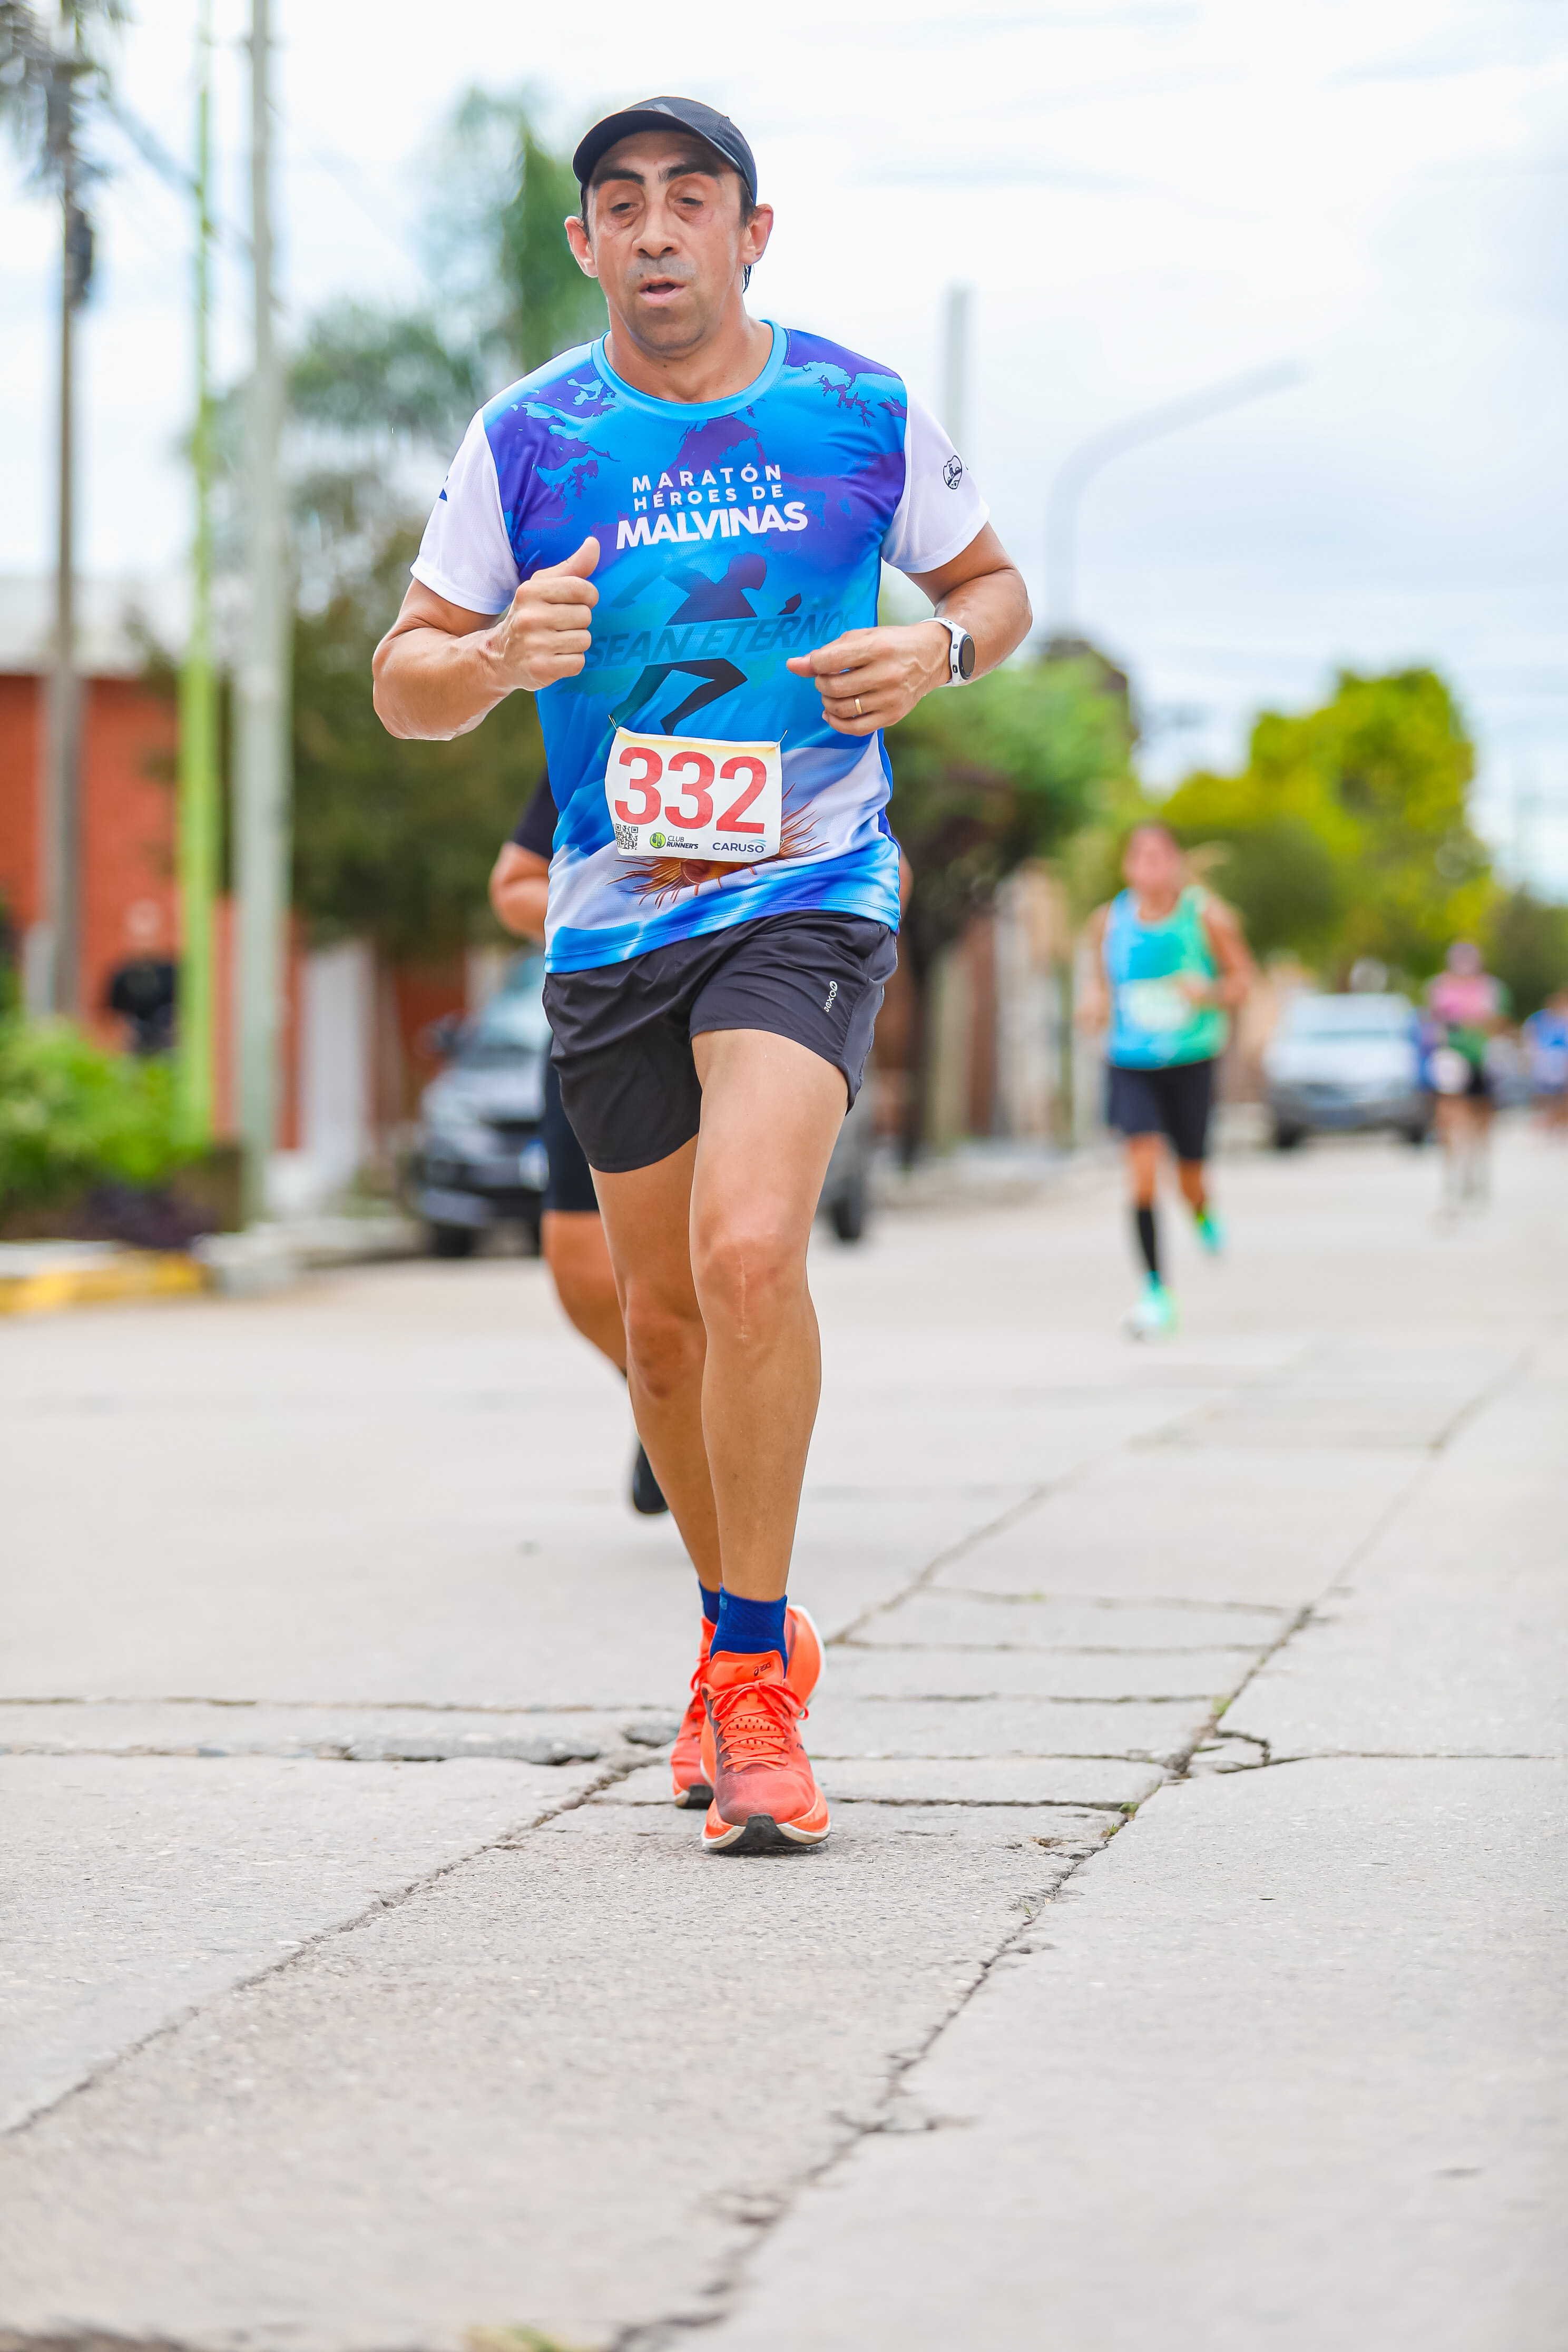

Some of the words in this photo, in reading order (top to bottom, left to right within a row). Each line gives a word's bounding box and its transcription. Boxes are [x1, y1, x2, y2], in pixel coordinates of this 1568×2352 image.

[632, 463, 781, 493] MARATÓN
[634, 489, 737, 511] HÉROES
[752, 484, 783, 500] DE
[616, 502, 808, 550] MALVINAS
[585, 626, 695, 668] SEAN
[615, 747, 767, 834] 332
[712, 842, 765, 853] CARUSO
